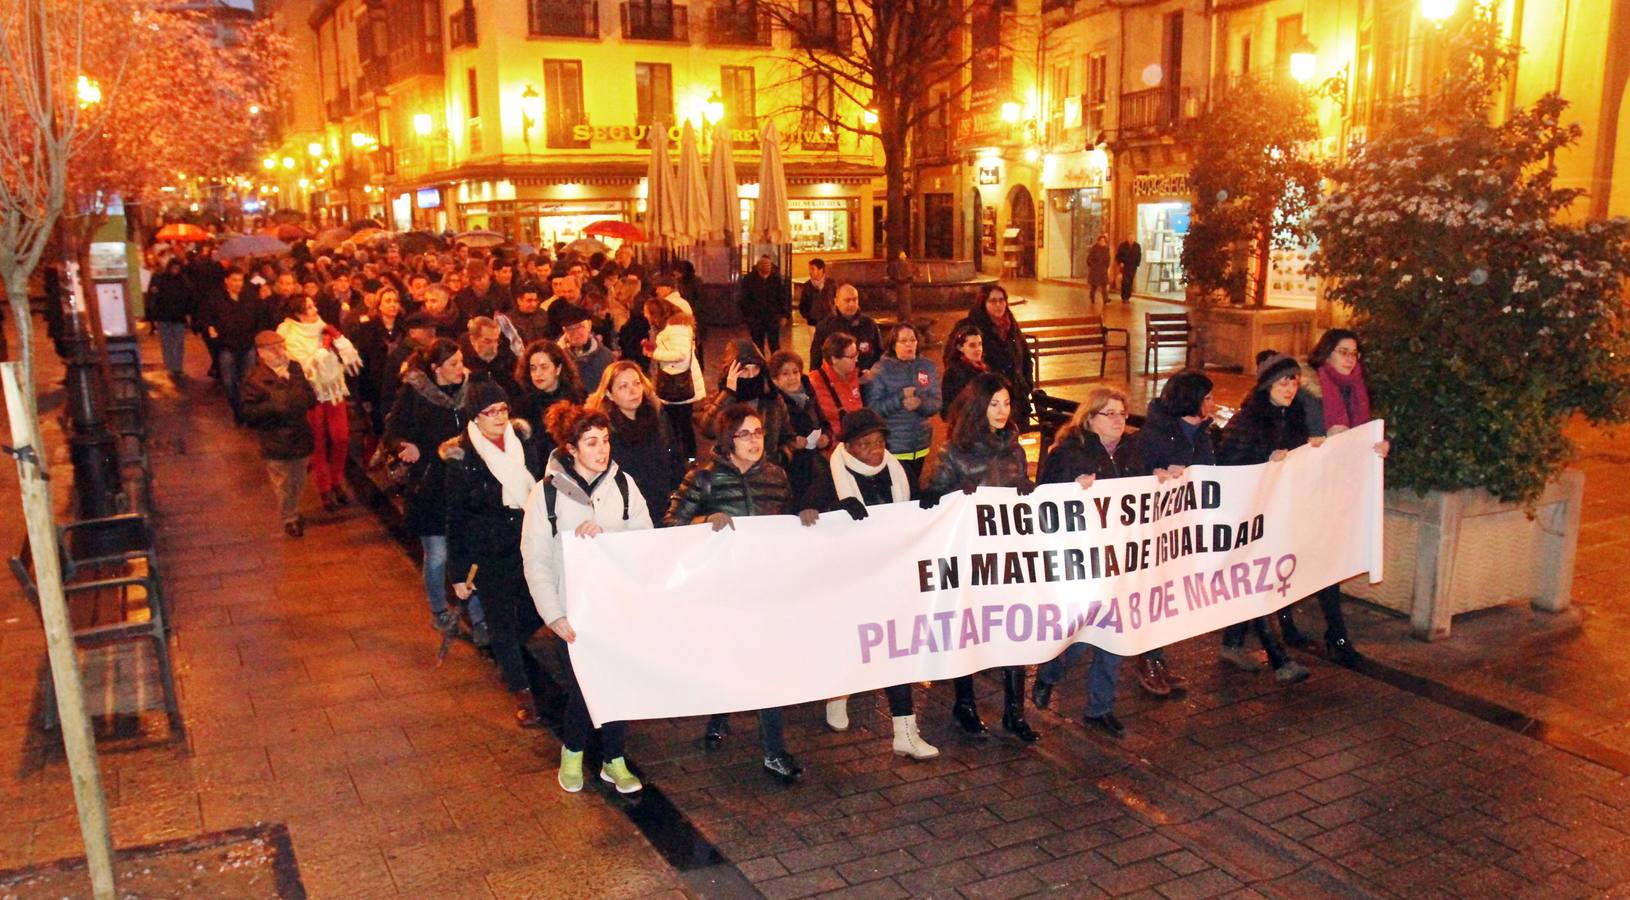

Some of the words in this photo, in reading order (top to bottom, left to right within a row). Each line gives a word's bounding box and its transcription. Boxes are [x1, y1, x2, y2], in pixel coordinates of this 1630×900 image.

[976, 500, 1086, 536] RIGOR
[1093, 496, 1111, 529] Y
[1120, 480, 1221, 526] SERIEDAD
[917, 556, 960, 593] EN
[971, 544, 1121, 586] MATERIA
[1124, 538, 1151, 573] DE
[1155, 513, 1264, 567] IGUALDAD
[857, 597, 1124, 665] PLATAFORMA
[1128, 591, 1142, 630] 8
[1149, 580, 1179, 623] DE
